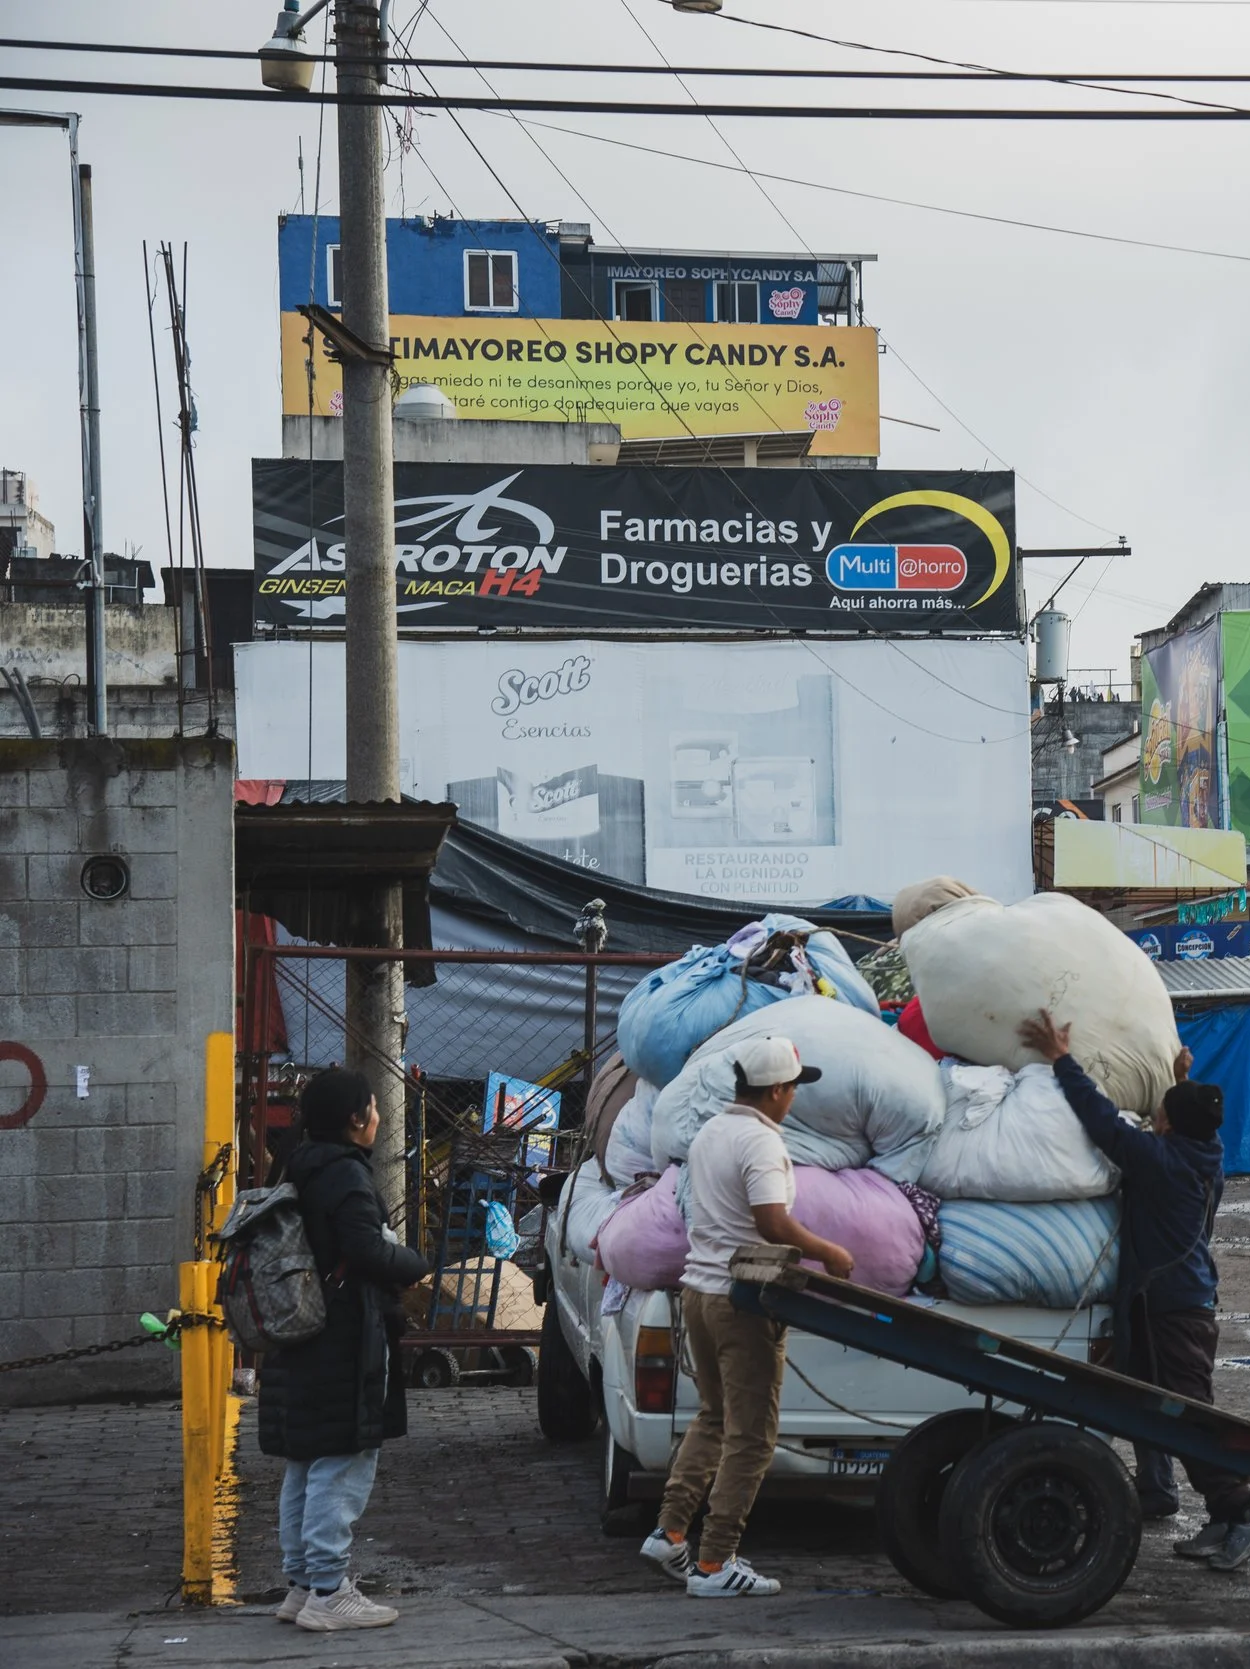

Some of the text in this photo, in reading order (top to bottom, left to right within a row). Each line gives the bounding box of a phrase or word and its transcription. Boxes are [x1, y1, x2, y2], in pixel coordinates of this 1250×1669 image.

[770, 295, 802, 310] Sophy
[774, 307, 799, 318] Candy
[322, 337, 845, 368] STIMAYOREO SHOPY CANDY S.A.
[434, 373, 482, 387] miedo
[489, 374, 502, 387] ni
[508, 375, 522, 388] te
[528, 374, 611, 390] desanimes
[617, 379, 673, 393] porque
[677, 380, 700, 393] yo,
[706, 379, 720, 392] tu
[725, 378, 769, 393] Señor
[774, 382, 782, 395] y
[787, 379, 823, 395] Dios,
[490, 395, 549, 413] contigo
[554, 396, 655, 413] dondequiera
[667, 400, 690, 414] que
[696, 400, 739, 415] vayas
[804, 408, 841, 423] Sophy
[809, 420, 836, 431] Candy
[600, 510, 833, 552] Farmacias y
[267, 537, 568, 575] ASROTON
[600, 553, 813, 593] Droguerias
[839, 554, 962, 582] Multi @horro
[258, 578, 476, 596] GINSEN MACA
[478, 567, 545, 596] H4
[829, 595, 966, 611] Aquí ahorra más...
[491, 655, 591, 716] Scott
[501, 718, 592, 740] Esencias
[532, 779, 583, 810] Scott
[684, 853, 809, 866] RESTAURANDO
[695, 867, 804, 880] LA DIGNIDAD
[700, 881, 799, 894] CON PLENITUD
